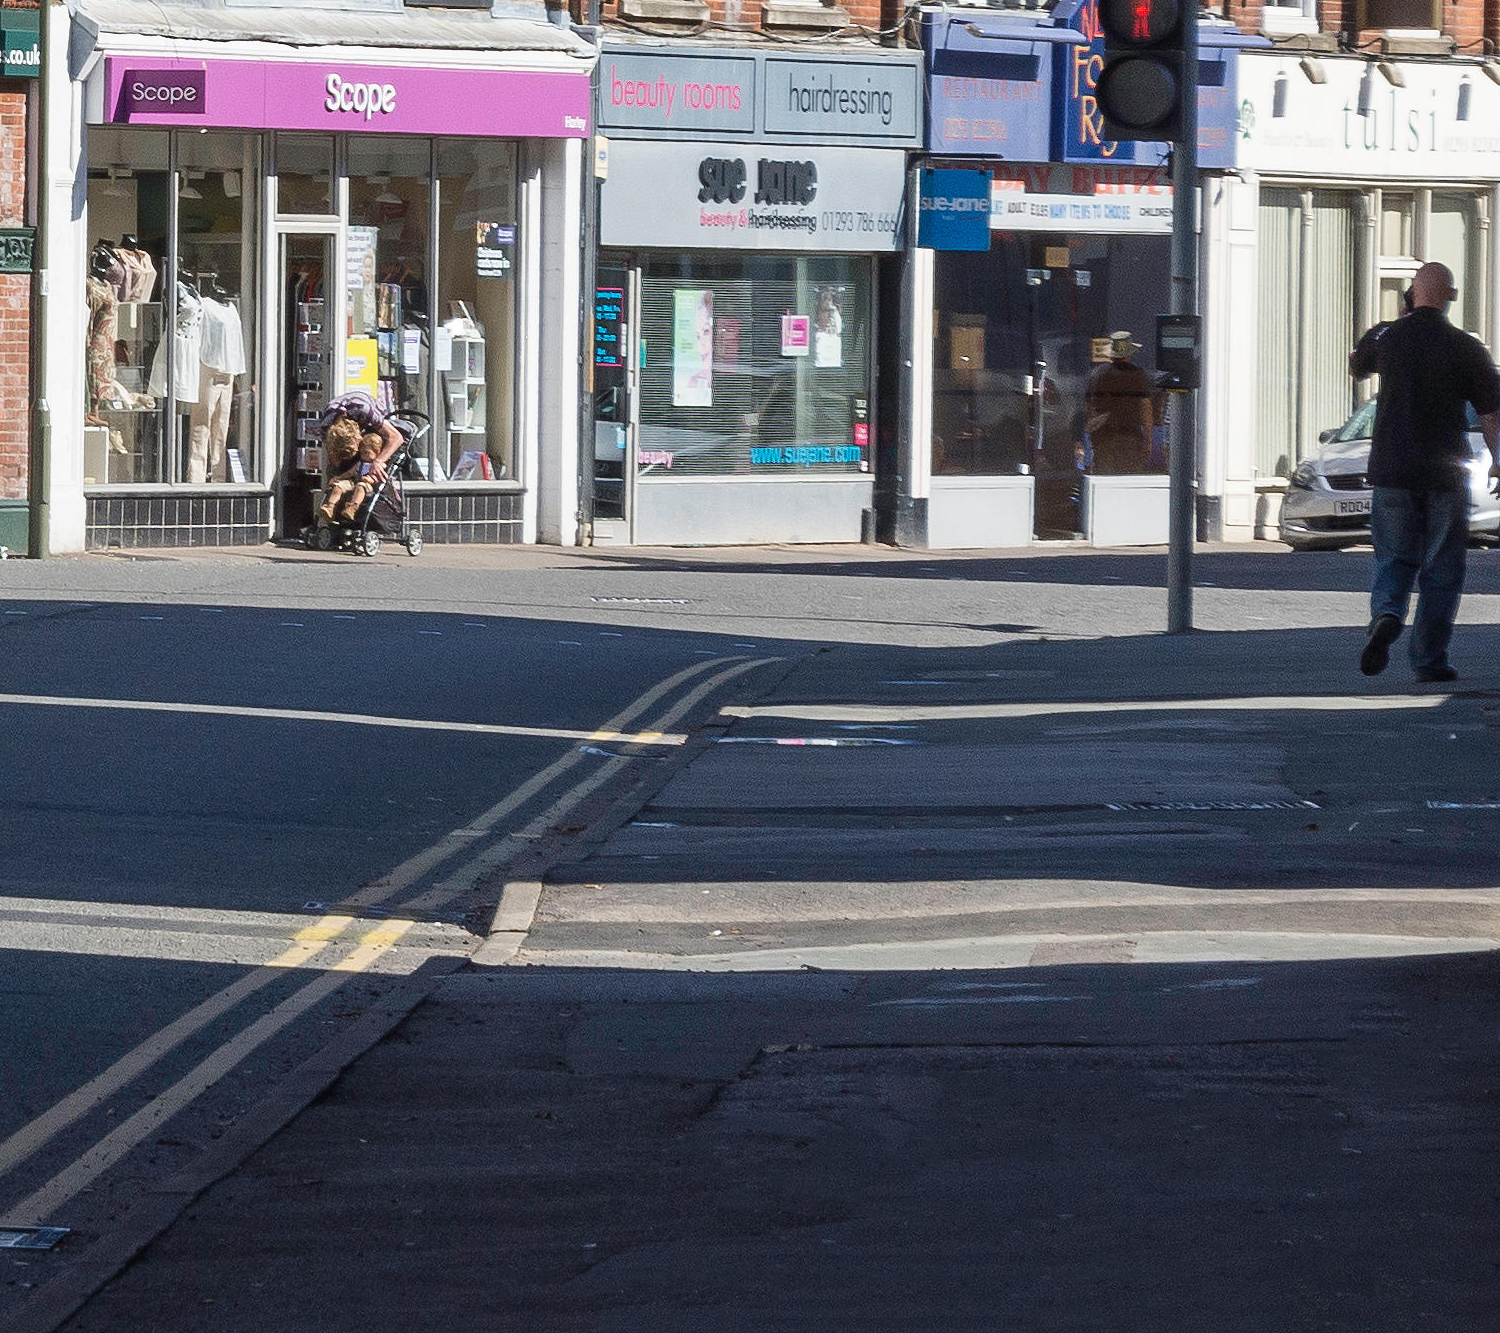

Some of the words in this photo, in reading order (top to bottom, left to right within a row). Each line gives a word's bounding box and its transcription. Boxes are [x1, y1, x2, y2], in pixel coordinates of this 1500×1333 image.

[132, 82, 197, 105] Scope
[325, 73, 396, 120] Scope
[611, 64, 676, 118] beauty
[683, 83, 741, 111] rooms
[789, 72, 893, 125] hairdressing
[942, 76, 1044, 101] RESTAURANT
[1342, 88, 1437, 152] tulsi
[821, 211, 854, 232] 01293
[856, 212, 875, 233] 786
[1340, 500, 1371, 514] RD04
